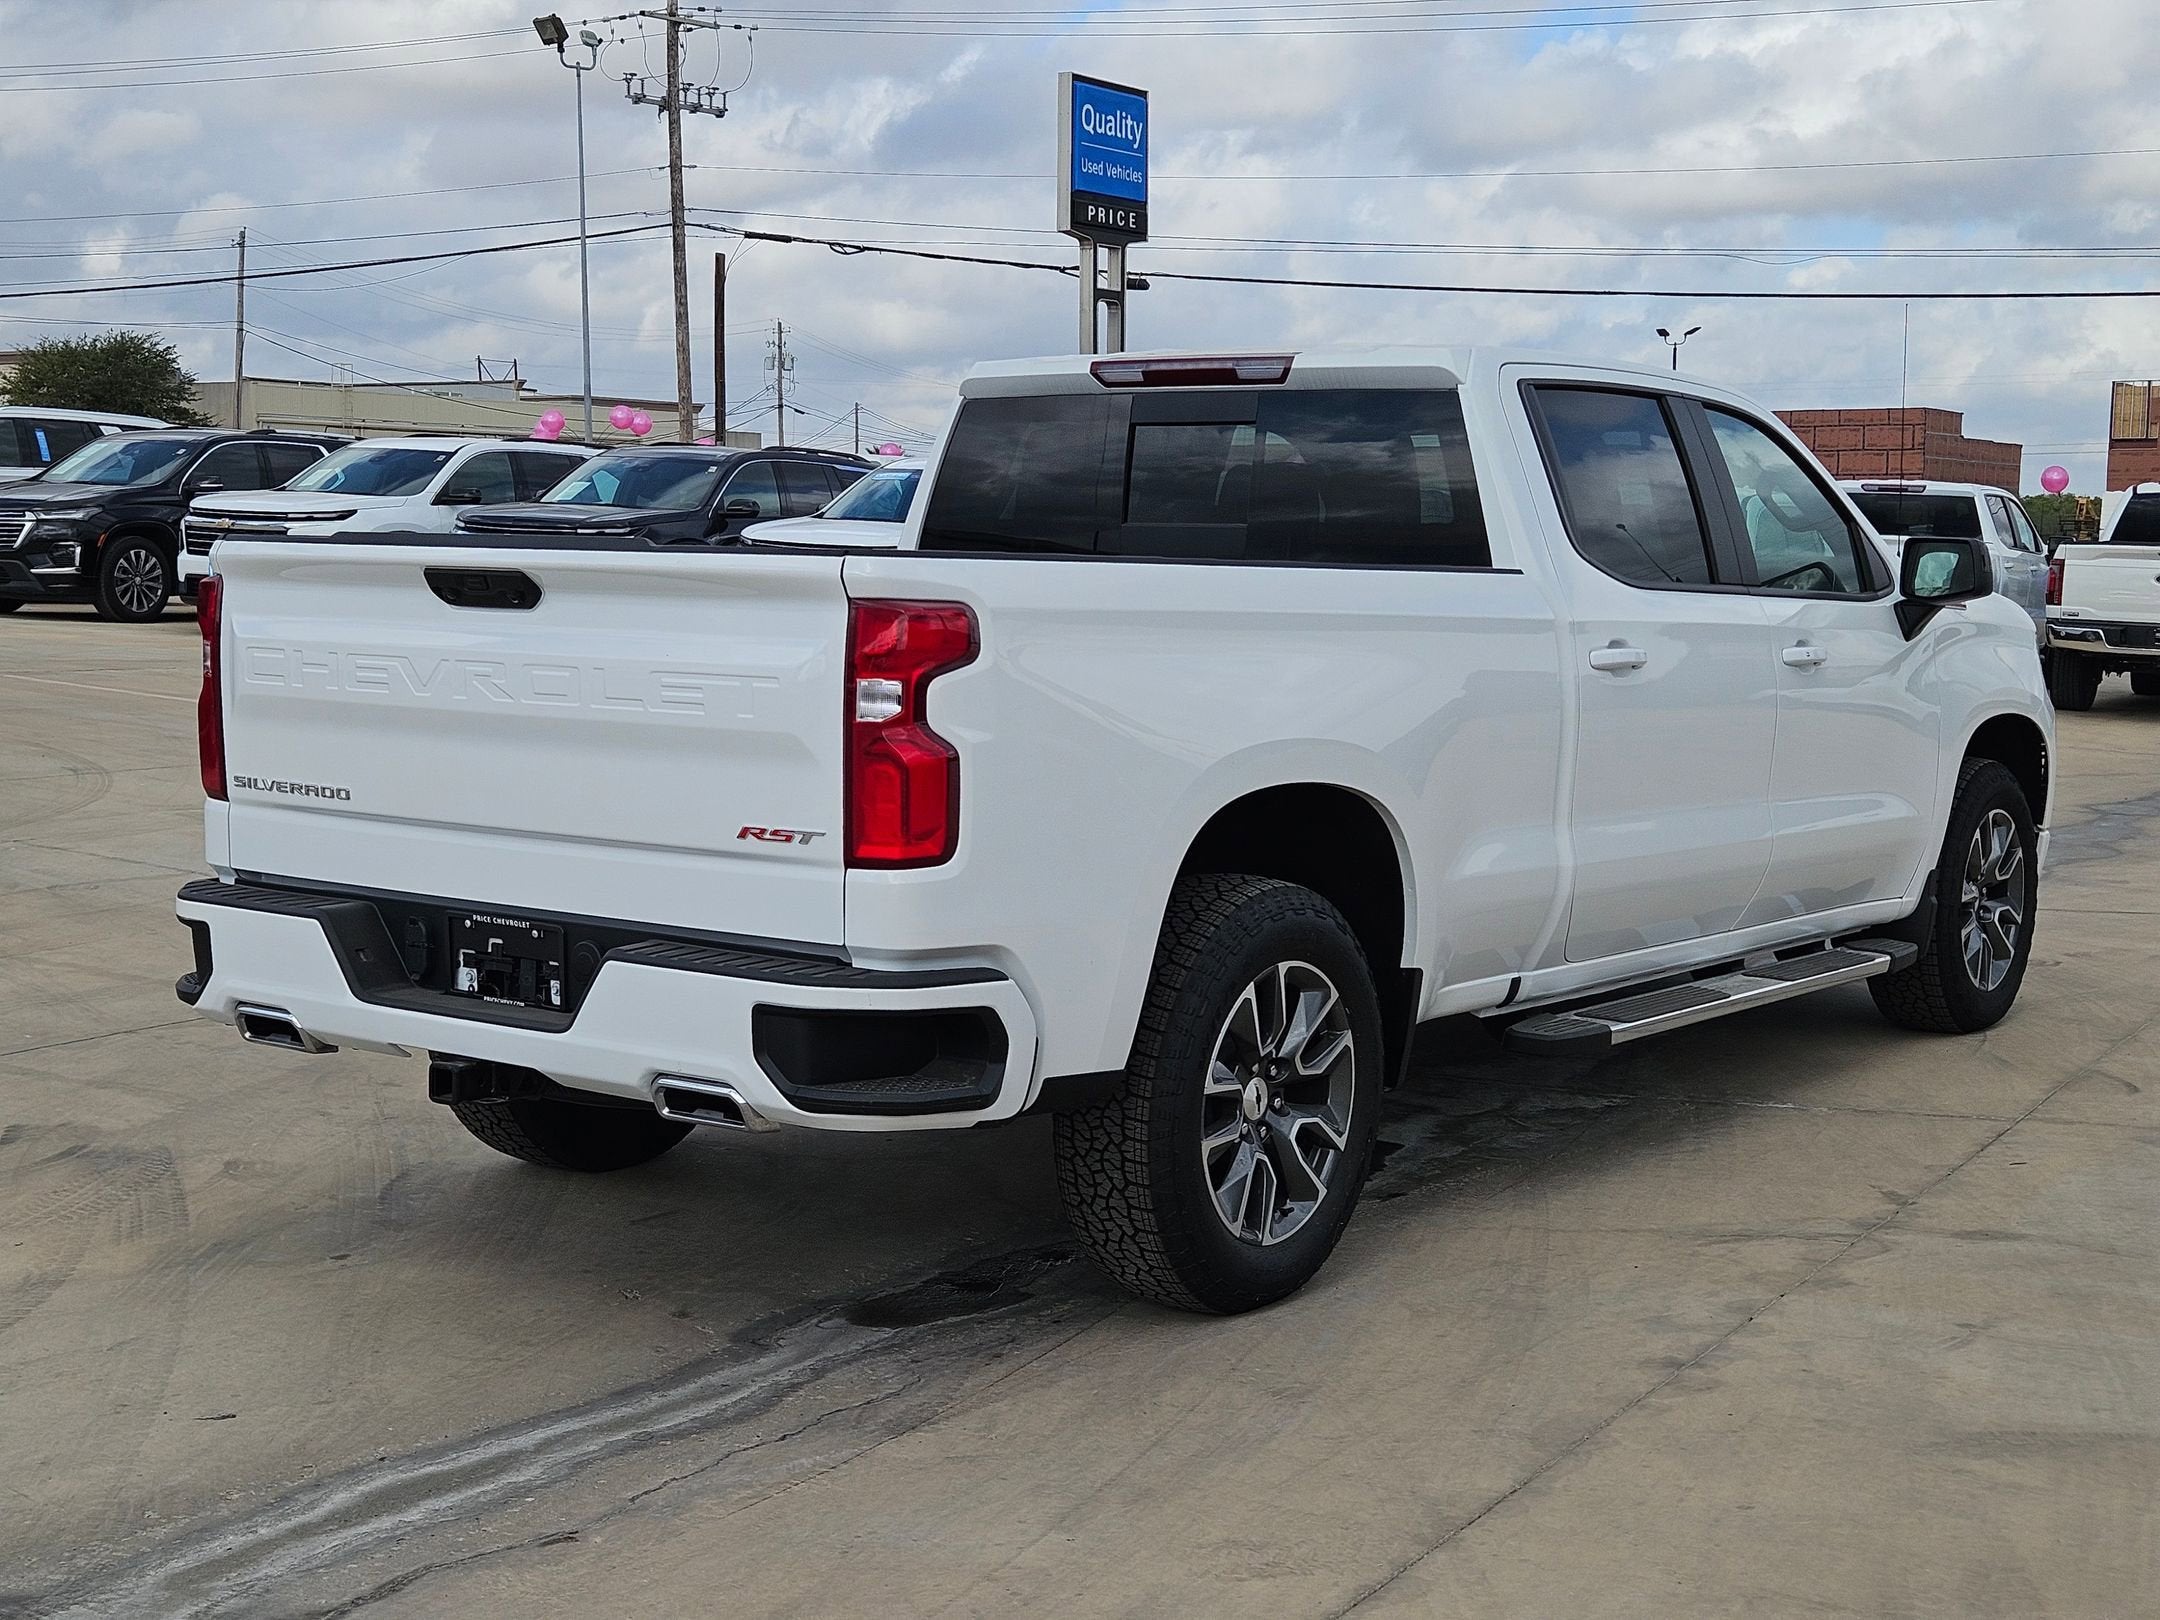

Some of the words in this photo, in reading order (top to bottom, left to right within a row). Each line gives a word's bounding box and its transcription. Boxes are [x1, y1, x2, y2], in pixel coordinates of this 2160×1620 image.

[1081, 103, 1143, 149] Quality
[1081, 157, 1104, 176] Used
[1105, 162, 1143, 183] Vehicles
[1088, 205, 1137, 228] PRICE
[246, 646, 779, 719] CHEVROLET
[233, 775, 351, 801] SILVERADO
[736, 826, 827, 845] RST
[472, 914, 491, 923] PRICE
[492, 917, 530, 928] CHEVROLET
